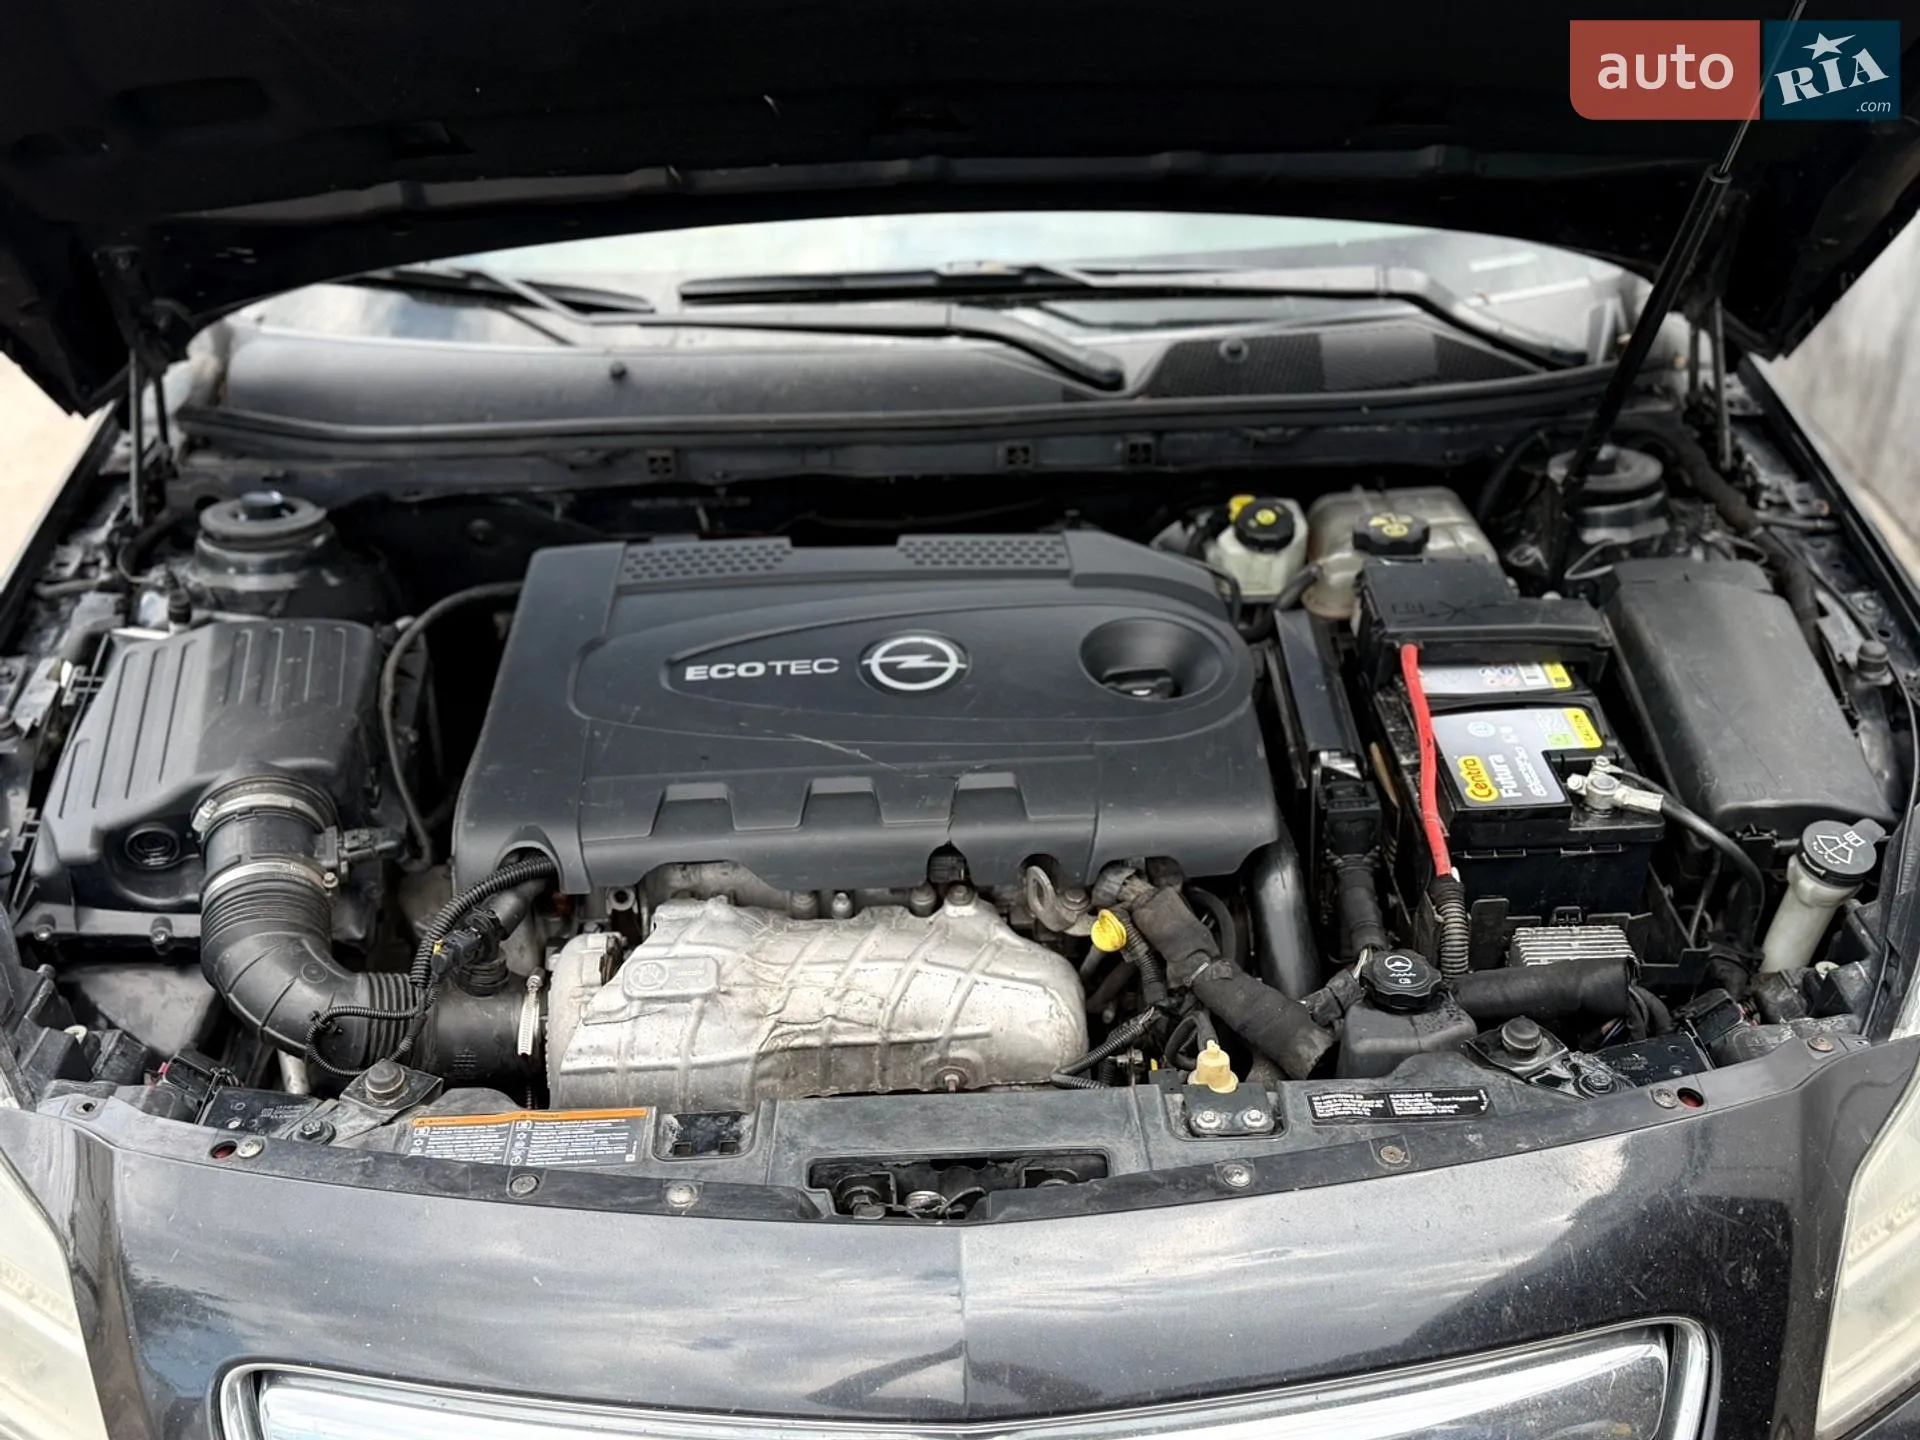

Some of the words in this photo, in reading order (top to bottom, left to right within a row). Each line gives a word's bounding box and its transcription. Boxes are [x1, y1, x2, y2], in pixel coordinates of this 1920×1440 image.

[684, 657, 841, 681] ECOTEC
[1462, 757, 1493, 800] Centro
[1489, 753, 1523, 799] Futura
